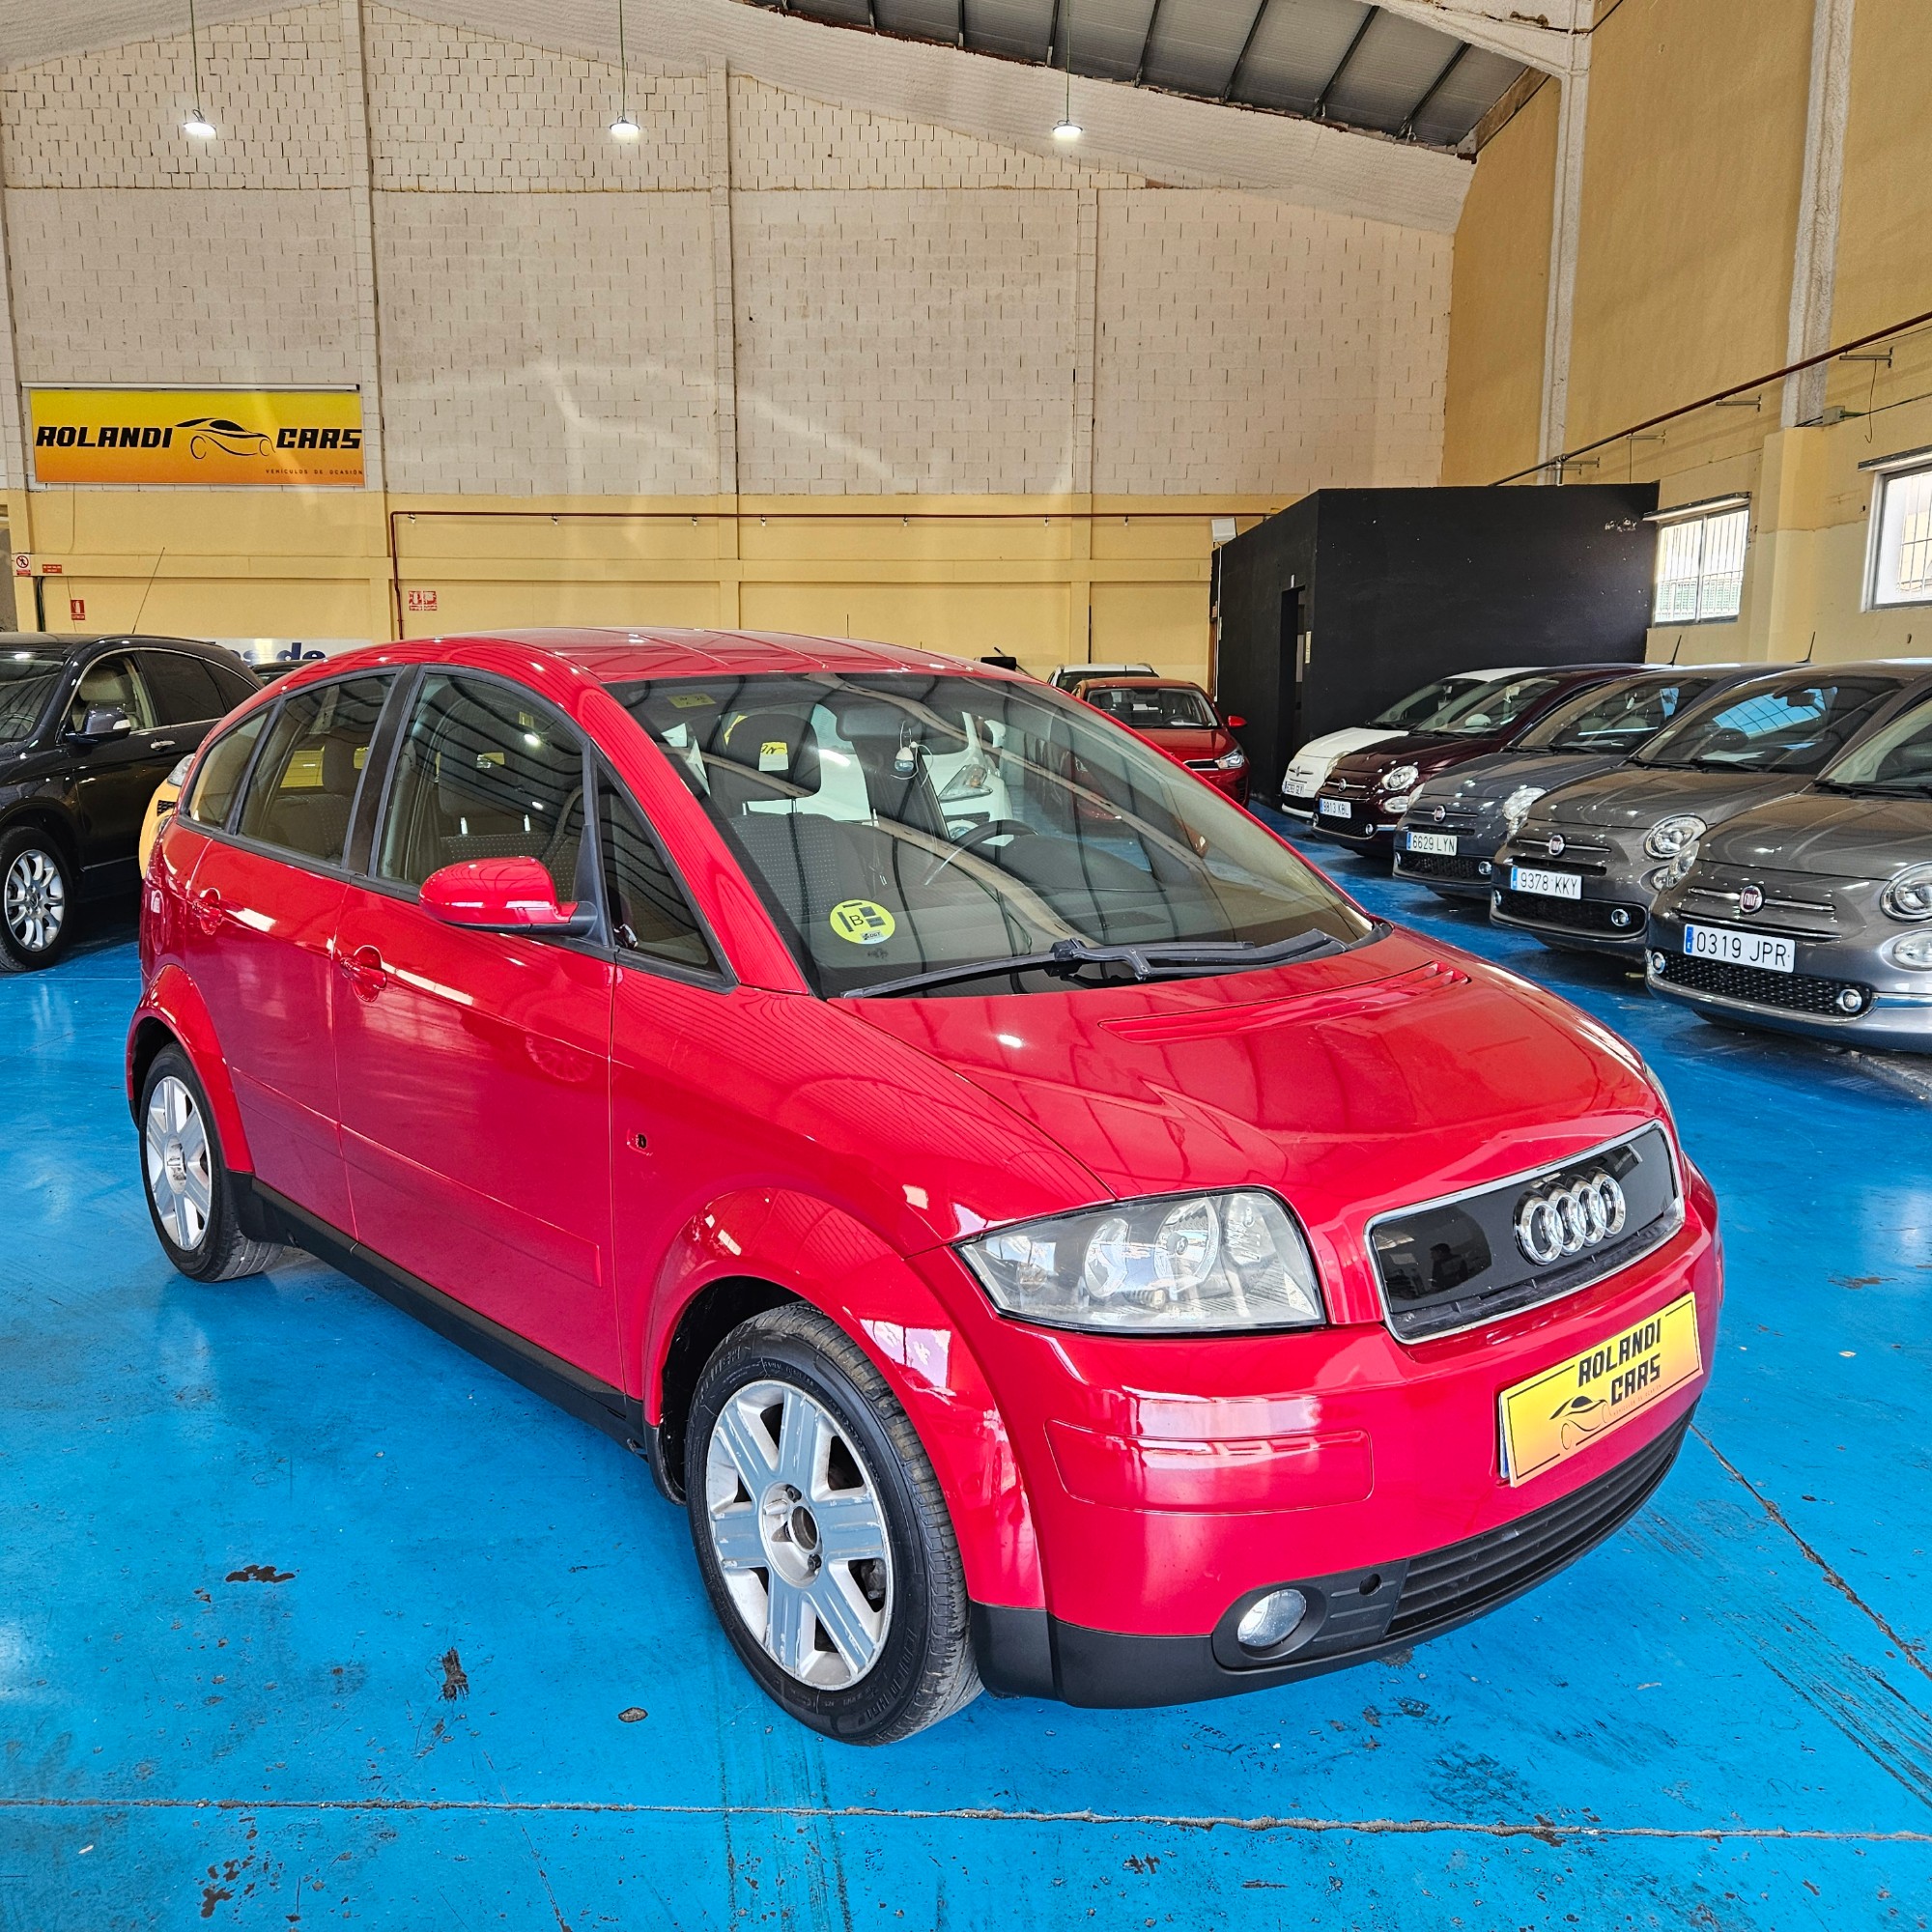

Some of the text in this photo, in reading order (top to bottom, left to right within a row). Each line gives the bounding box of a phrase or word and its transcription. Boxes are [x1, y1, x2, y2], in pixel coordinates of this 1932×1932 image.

[36, 426, 362, 449] ROLANDI CARS
[1412, 835, 1456, 853] 6629 LYN
[1520, 871, 1577, 895] 9378 KKY
[849, 915, 864, 926] B
[1696, 931, 1787, 967] 0319 JPR
[1578, 1318, 1661, 1388] ROLANDI
[1611, 1352, 1661, 1406] CARS
